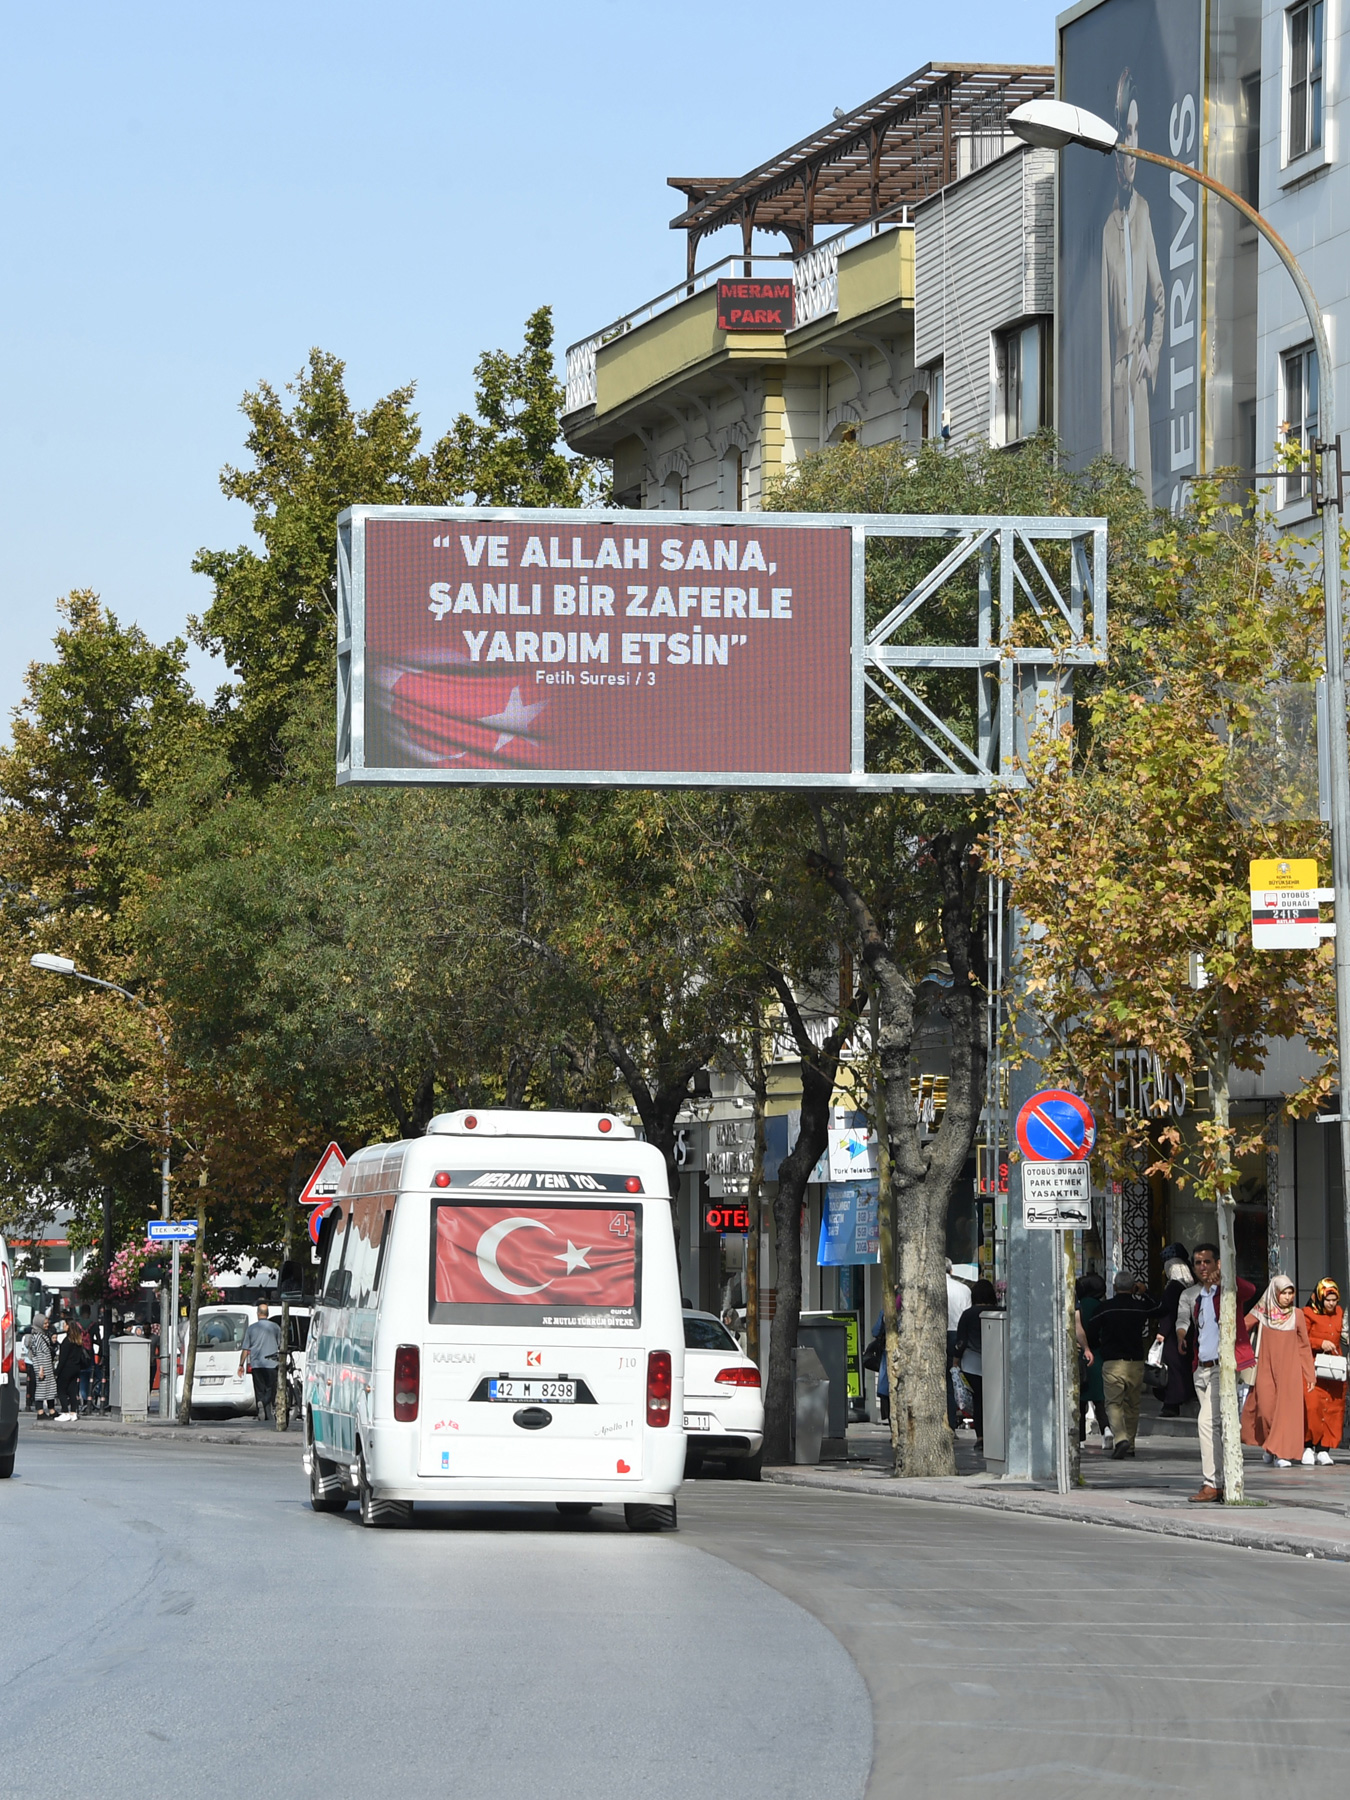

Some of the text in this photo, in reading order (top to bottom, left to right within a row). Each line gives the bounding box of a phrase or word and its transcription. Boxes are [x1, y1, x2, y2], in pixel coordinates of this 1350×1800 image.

[721, 284, 790, 298] MERAM
[730, 309, 782, 323] PARK
[459, 535, 509, 567] VE
[519, 536, 649, 569] ALLAH
[659, 538, 777, 577] SANA,
[427, 575, 793, 621] ŞANLI BİR ZAFERLE
[462, 630, 609, 664] YARDIM
[535, 670, 575, 685] Fetih
[579, 670, 630, 686] Suresi
[647, 671, 656, 686] 3
[1281, 891, 1310, 899] OTOBÜS
[850, 1167, 878, 1175] Telekom
[1026, 1166, 1085, 1176] OTOBÜS DURAĞI
[468, 1172, 533, 1188] MERAM
[569, 1174, 608, 1191] YOL
[1030, 1178, 1082, 1187] PARK ETMEK
[1031, 1189, 1083, 1198] YASAKTIR.
[609, 1213, 630, 1237] 4
[553, 1317, 577, 1326] MUTLU
[432, 1352, 476, 1364] KARSAN
[618, 1357, 637, 1370] J10
[498, 1383, 573, 1397] 42 M 8298
[594, 1422, 623, 1437] Apollo
